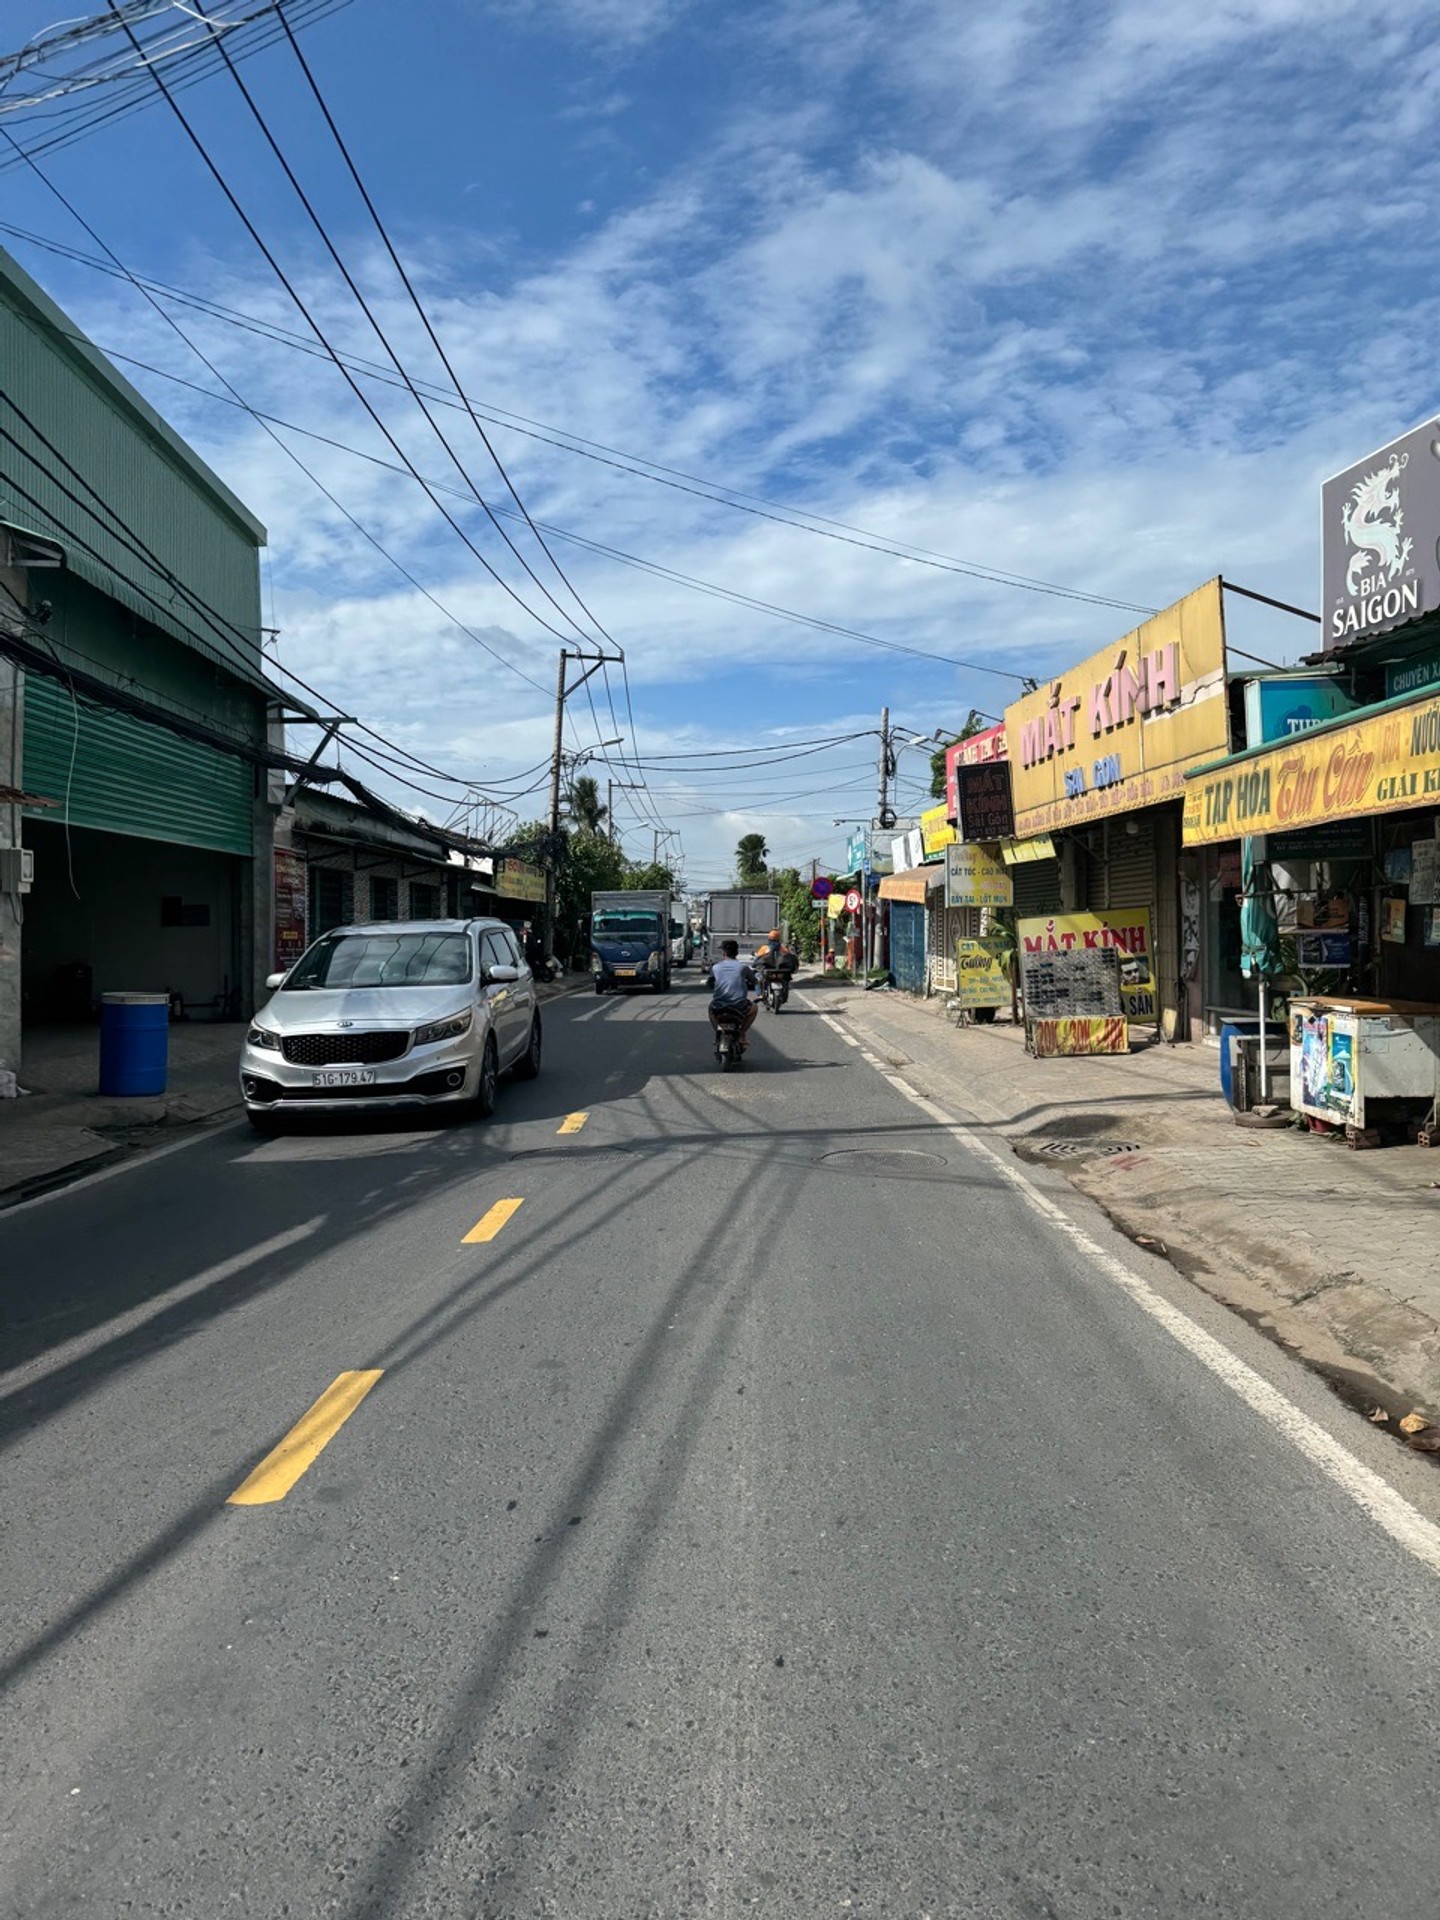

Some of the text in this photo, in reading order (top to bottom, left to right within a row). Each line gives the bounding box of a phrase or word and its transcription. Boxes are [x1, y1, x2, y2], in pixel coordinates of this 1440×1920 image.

[1360, 571, 1387, 597] BIA
[1332, 579, 1418, 638] SAIGON
[1393, 663, 1430, 692] CHUYÊN
[1020, 641, 1181, 768] MẮT KÍNH
[1204, 779, 1233, 834] TẠP
[1237, 761, 1271, 819] HÓA
[1377, 768, 1418, 802] GIẢI
